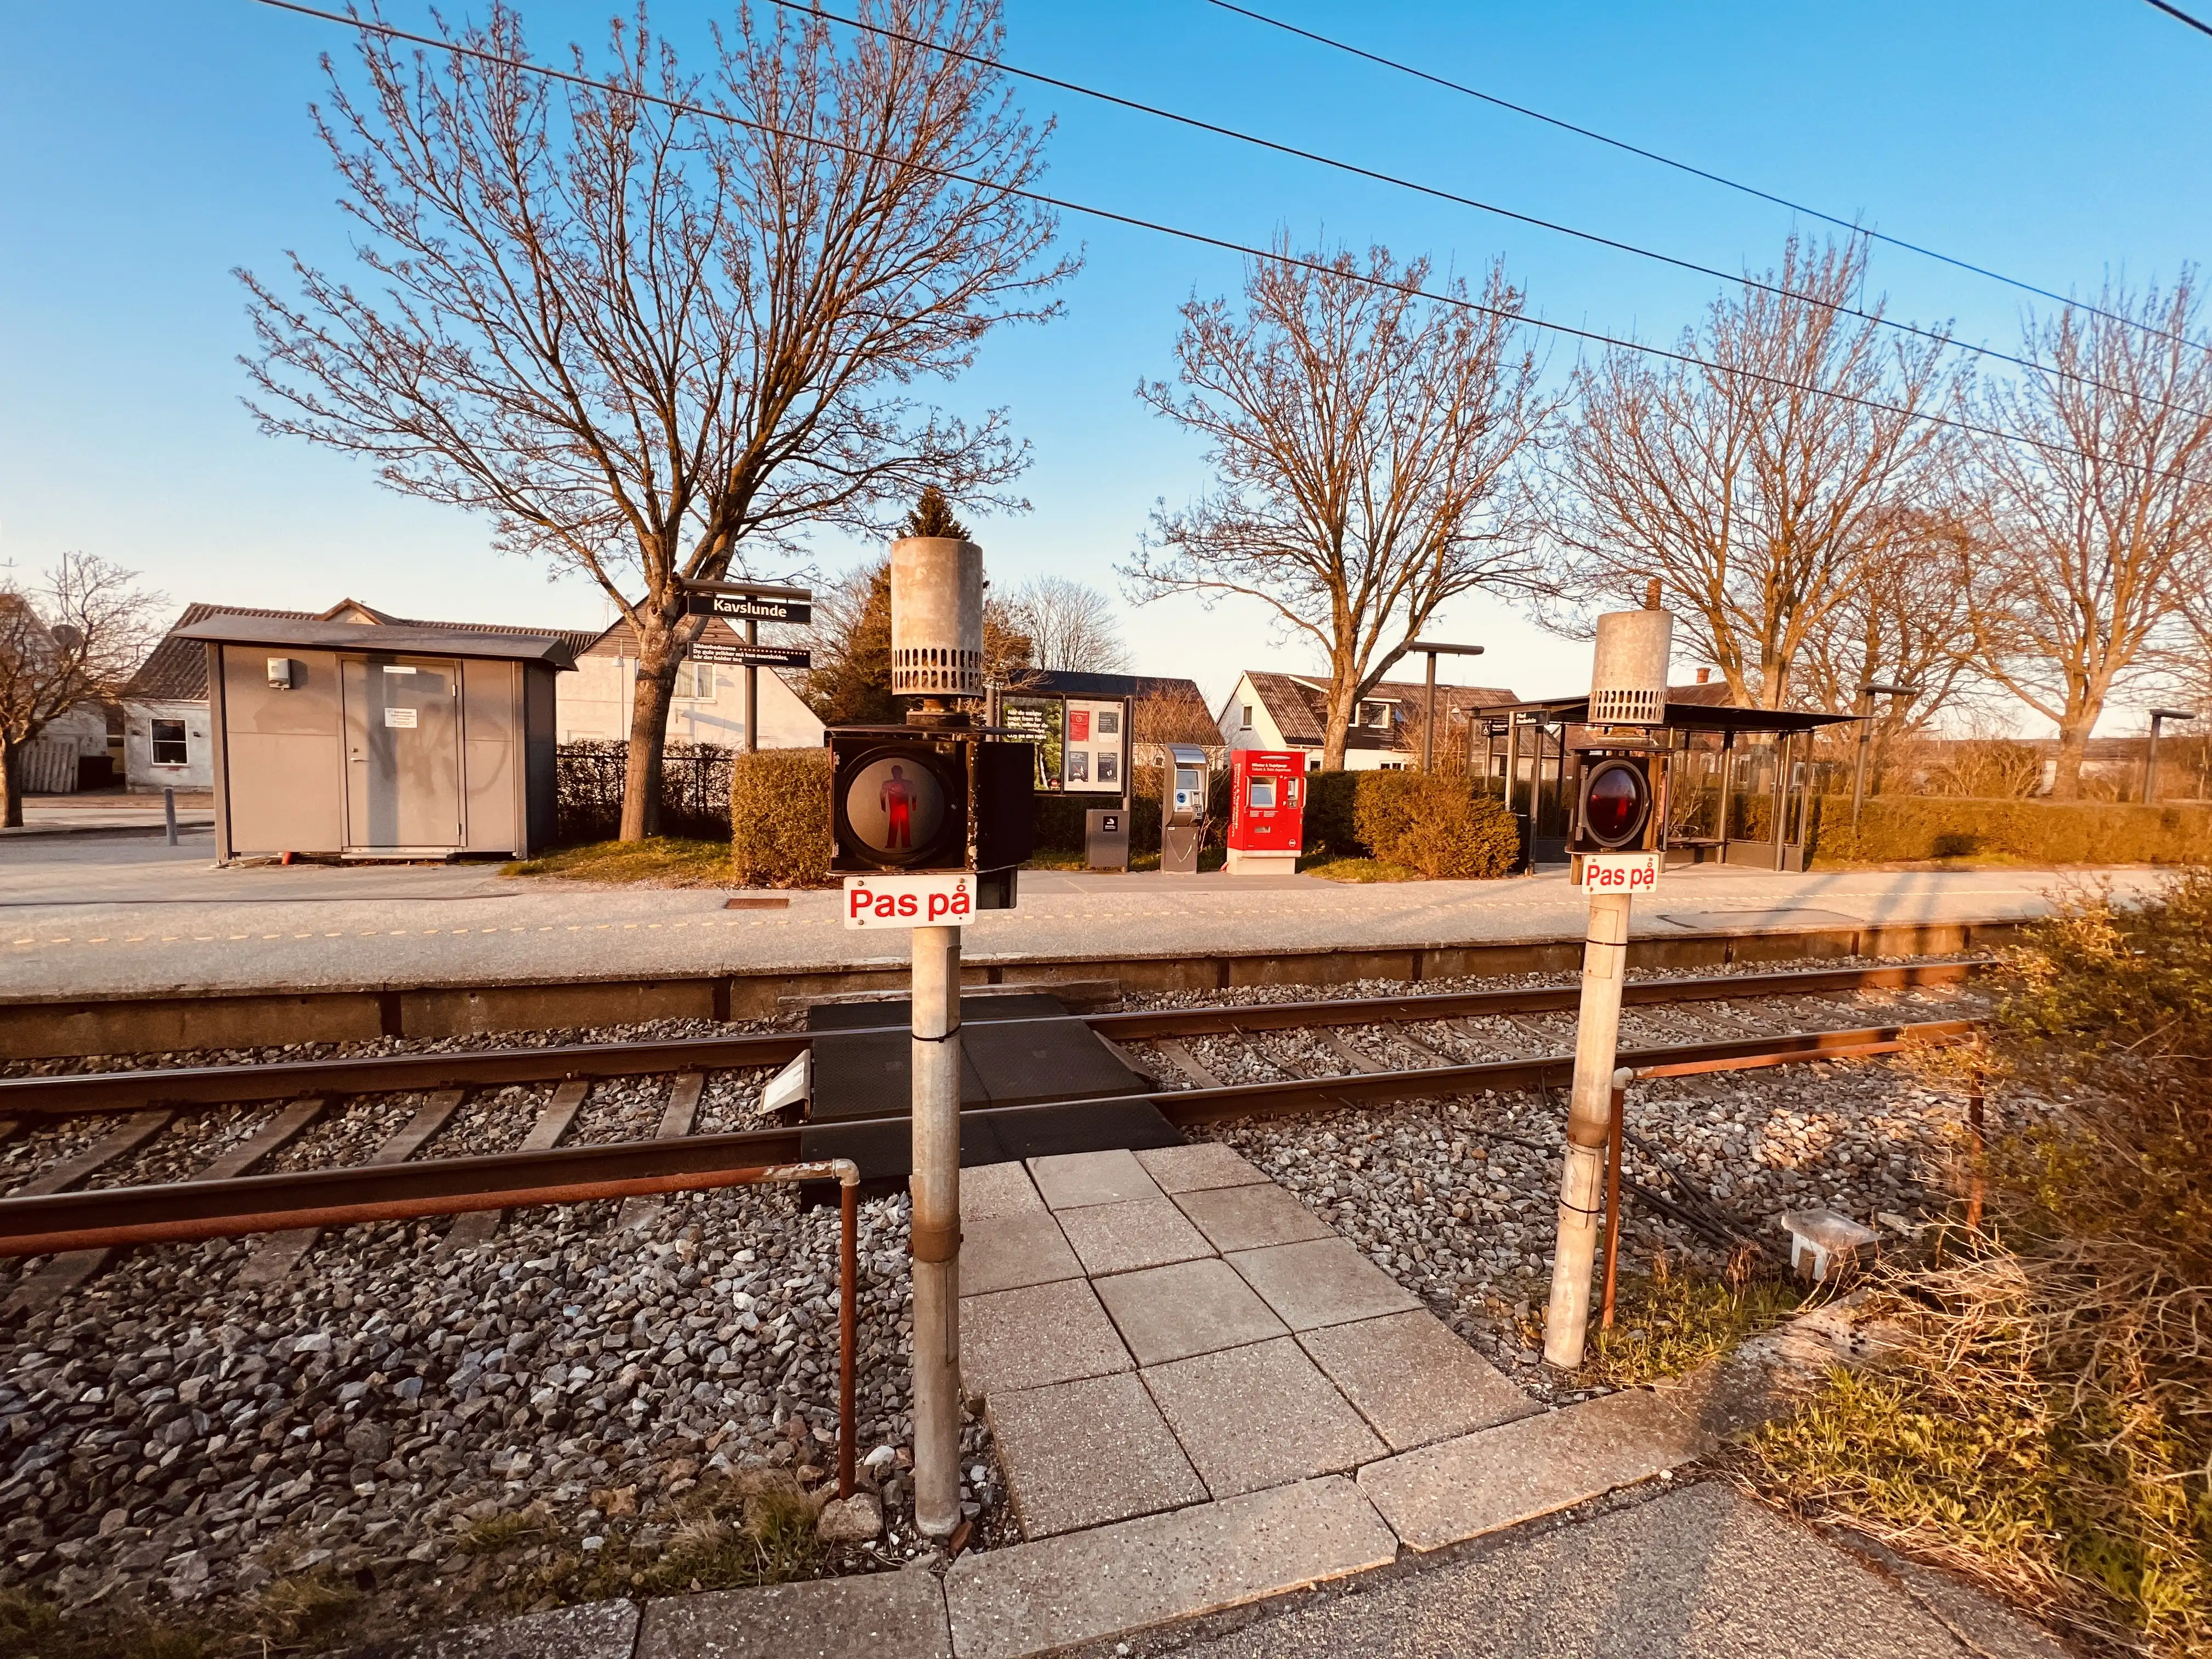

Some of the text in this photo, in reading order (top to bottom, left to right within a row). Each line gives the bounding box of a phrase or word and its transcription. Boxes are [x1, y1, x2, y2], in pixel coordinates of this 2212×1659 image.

[714, 599, 787, 618] Kavslunde
[1586, 862, 1654, 889] Pas på
[850, 884, 970, 922] Pas på
